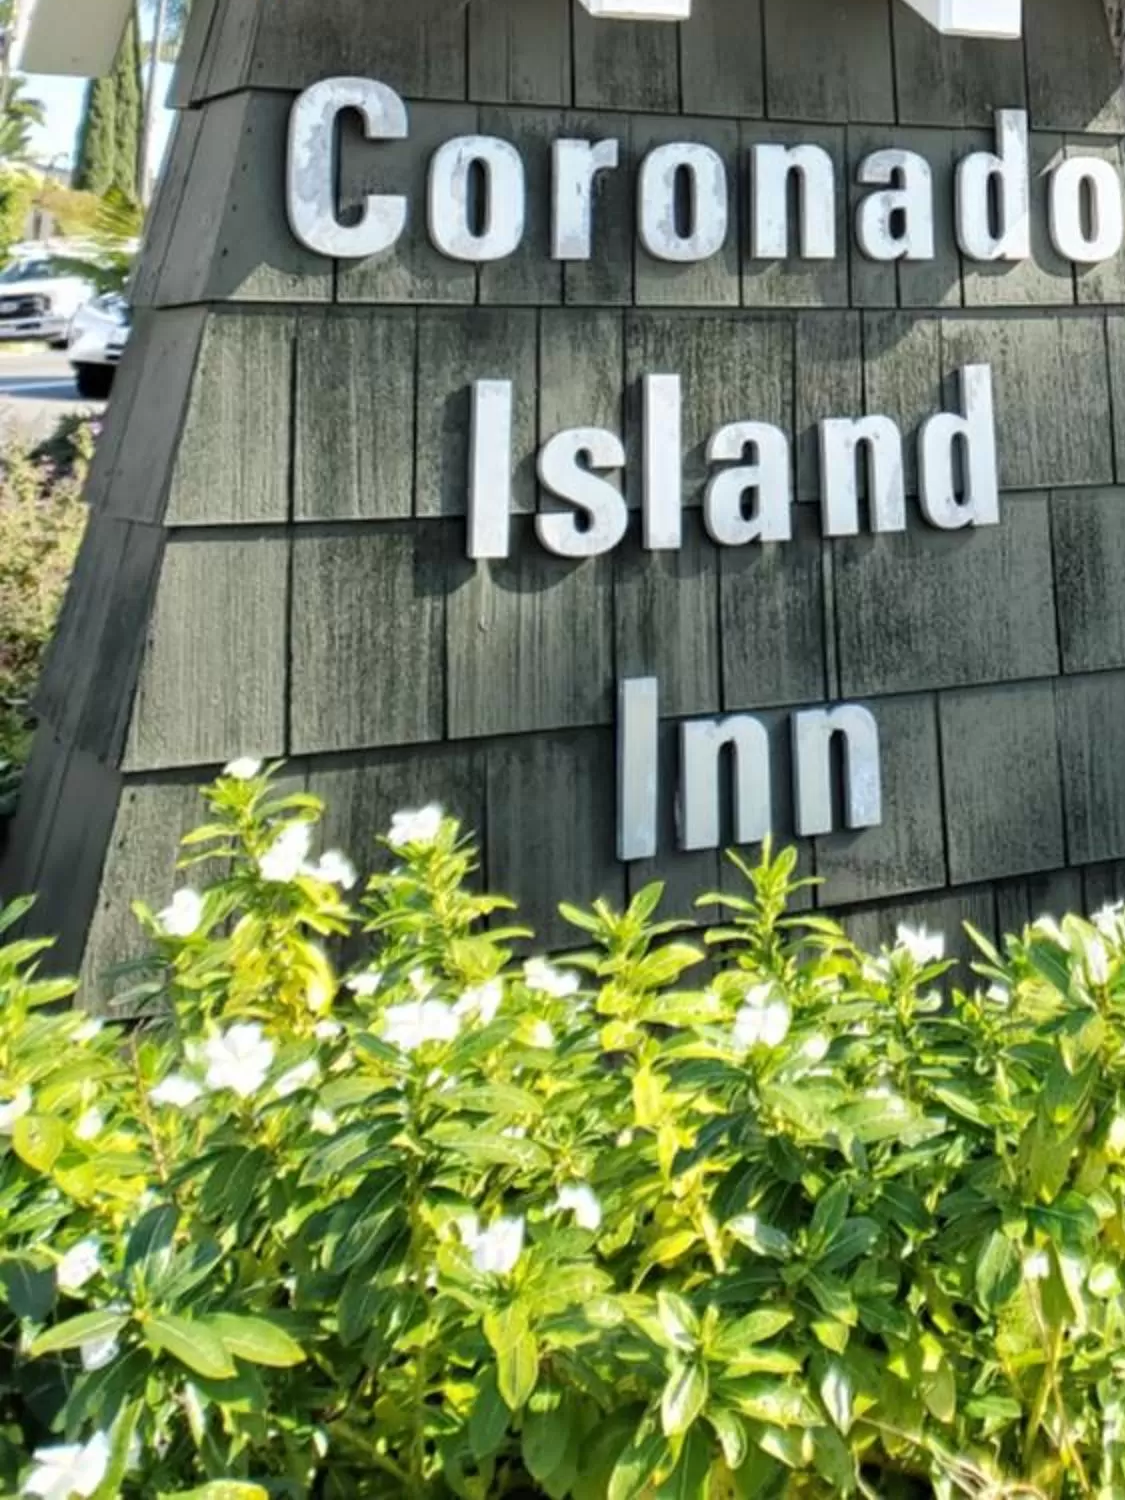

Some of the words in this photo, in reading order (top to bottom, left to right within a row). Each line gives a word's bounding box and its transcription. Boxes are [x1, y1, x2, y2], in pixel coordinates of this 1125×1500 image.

[286, 75, 1123, 262] Coronado
[467, 364, 1000, 559] Island
[616, 676, 883, 861] Inn
